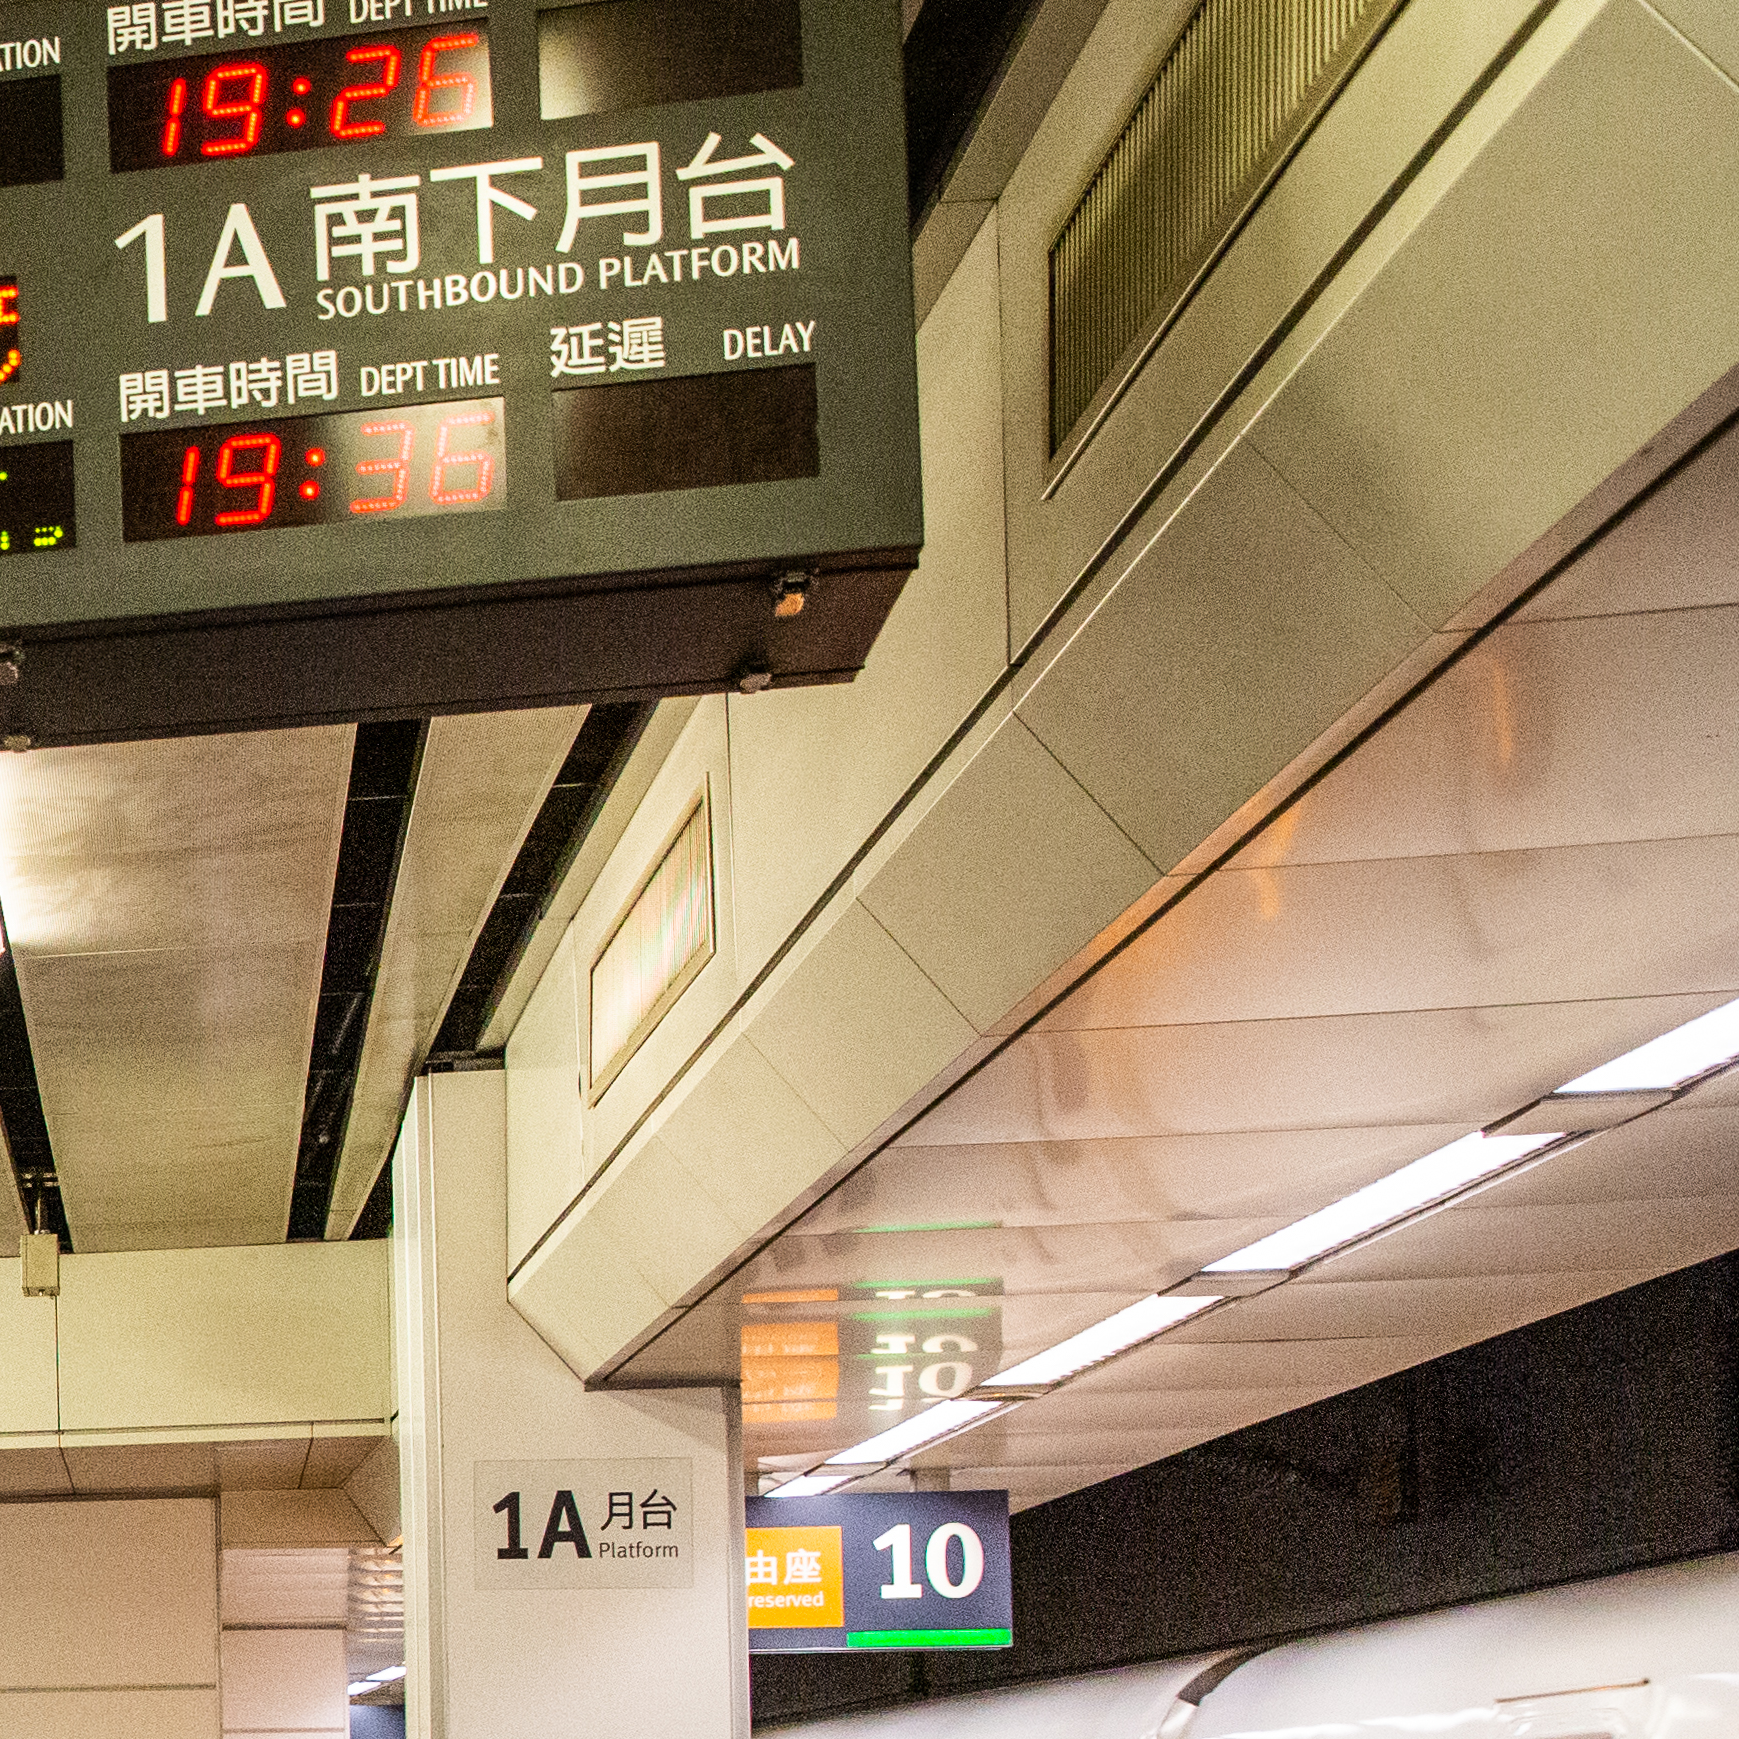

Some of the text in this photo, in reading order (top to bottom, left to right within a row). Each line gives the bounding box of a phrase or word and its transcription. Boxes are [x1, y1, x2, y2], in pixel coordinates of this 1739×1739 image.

[163, 32, 481, 156] 19:26
[115, 131, 796, 324] 1A 南下月台
[317, 238, 800, 320] SOUTHBOUND PLATFORM
[120, 349, 499, 422] 開車時間 DEPT TIME
[549, 317, 815, 378] 延遲 DELAY
[175, 412, 495, 527] 19:36
[492, 1489, 678, 1560] 1A 月台
[599, 1541, 679, 1559] Platform
[873, 1522, 984, 1599] 10
